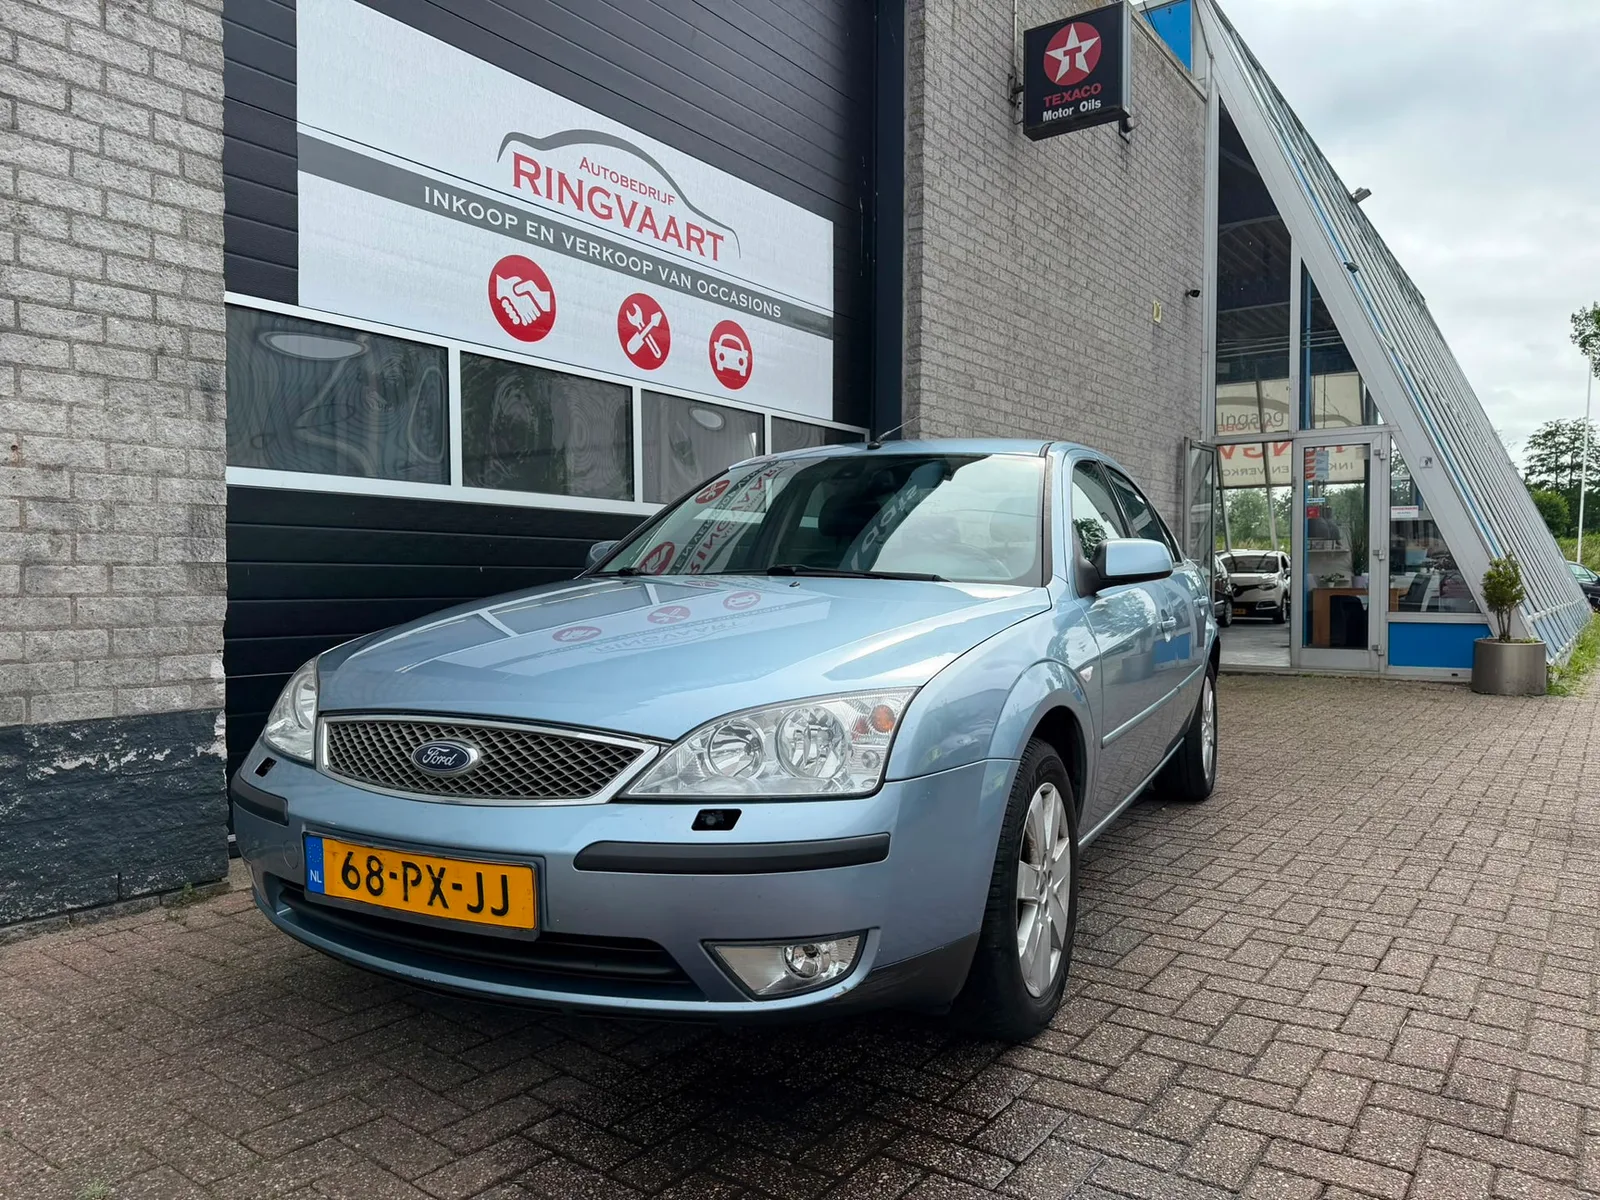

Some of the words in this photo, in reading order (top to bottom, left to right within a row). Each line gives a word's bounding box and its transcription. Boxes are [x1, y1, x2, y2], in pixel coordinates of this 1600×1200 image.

[1042, 106, 1075, 122] Motor
[1079, 99, 1102, 112] Oils
[1043, 83, 1102, 107] TEXACO
[579, 156, 676, 206] AUTOBEDRIJF
[512, 151, 725, 261] RINGVAART
[424, 185, 518, 231] INKOOP
[525, 221, 555, 245] EN
[561, 232, 654, 276] VERKOOP
[658, 265, 692, 290] VAN
[697, 280, 782, 319] OCCASIONS
[422, 747, 458, 767] Ford
[310, 869, 322, 884] NL
[341, 851, 510, 917] 68-PX-JJ
